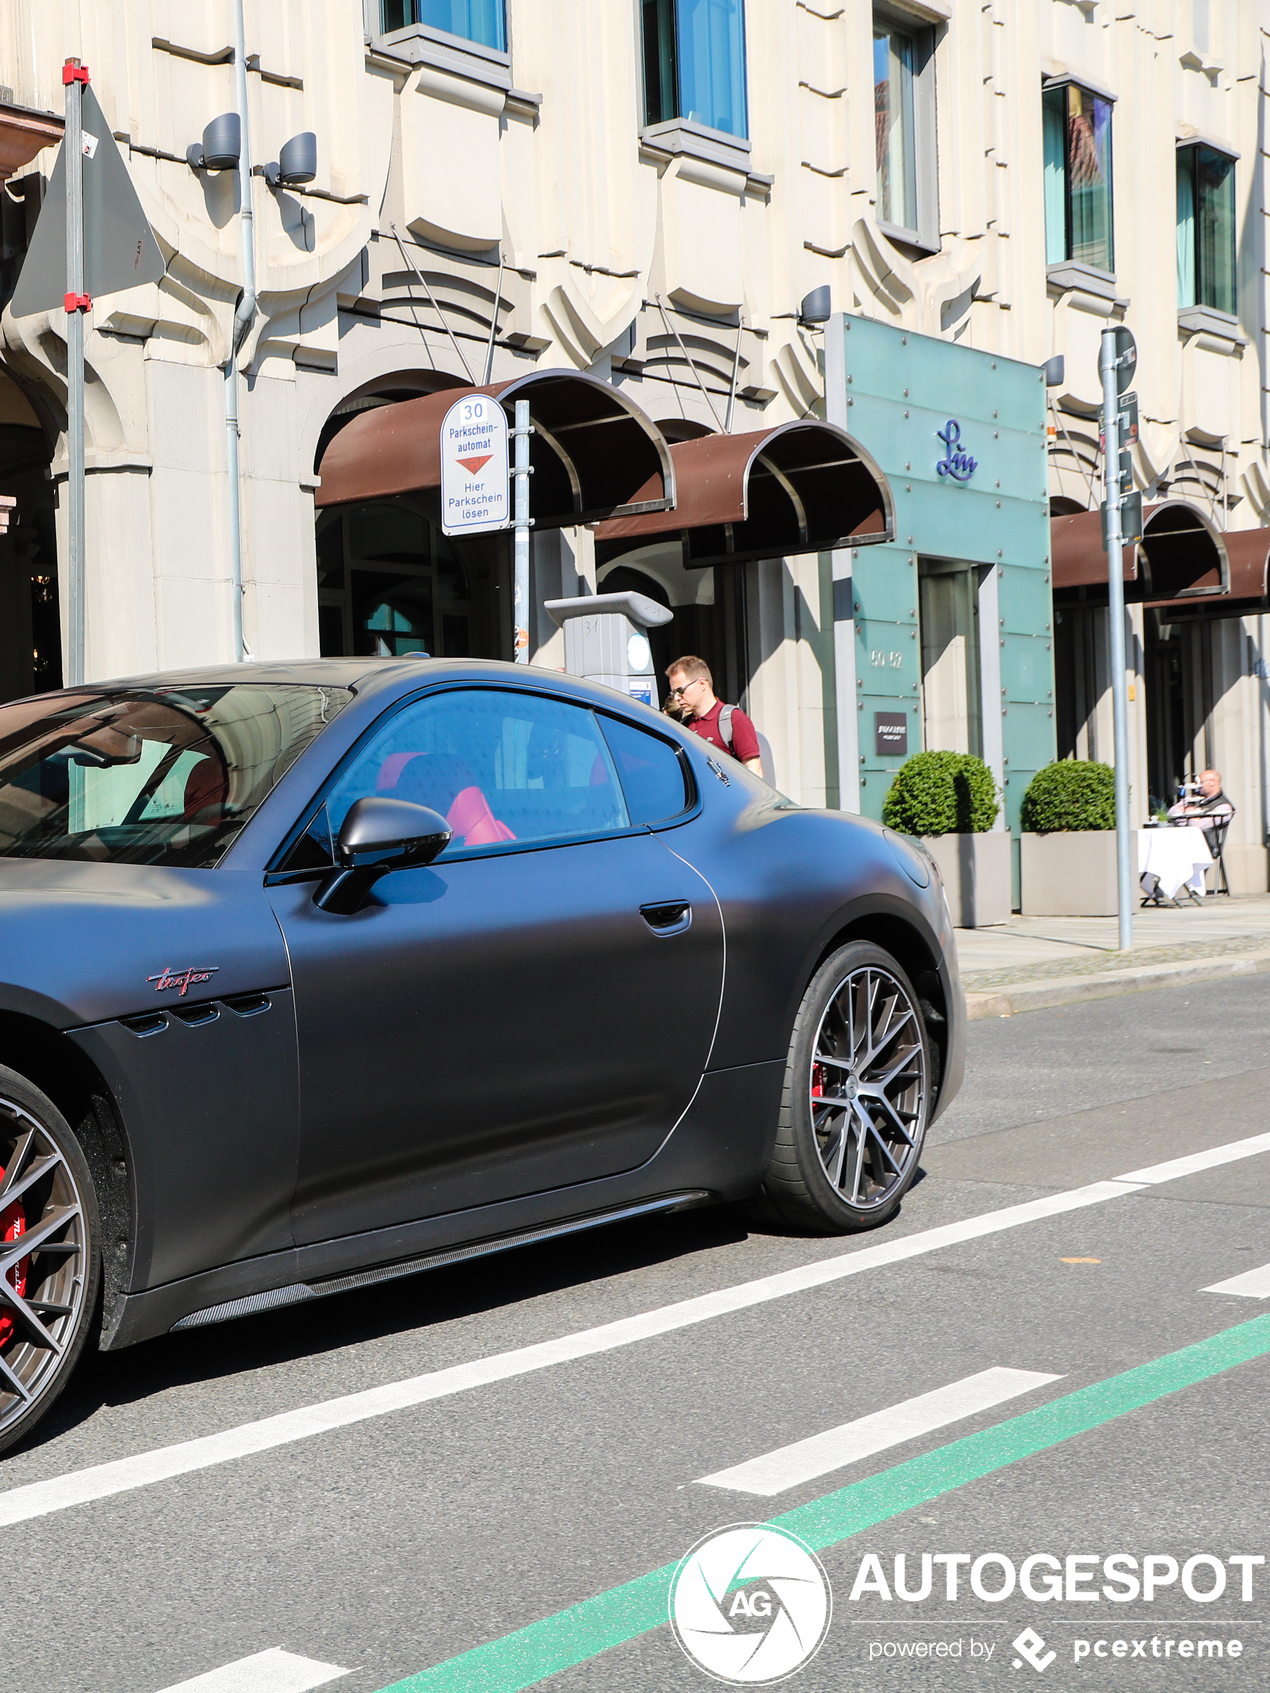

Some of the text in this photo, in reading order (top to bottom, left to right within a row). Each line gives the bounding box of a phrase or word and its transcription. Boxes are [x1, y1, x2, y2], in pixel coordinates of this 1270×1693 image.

[464, 403, 483, 420] 30
[450, 424, 499, 439] Parkschein-
[457, 439, 491, 453] automat
[464, 482, 485, 493] Hier
[448, 492, 503, 508] Parkschein
[462, 508, 489, 520] lösen
[146, 967, 219, 997] trofeo
